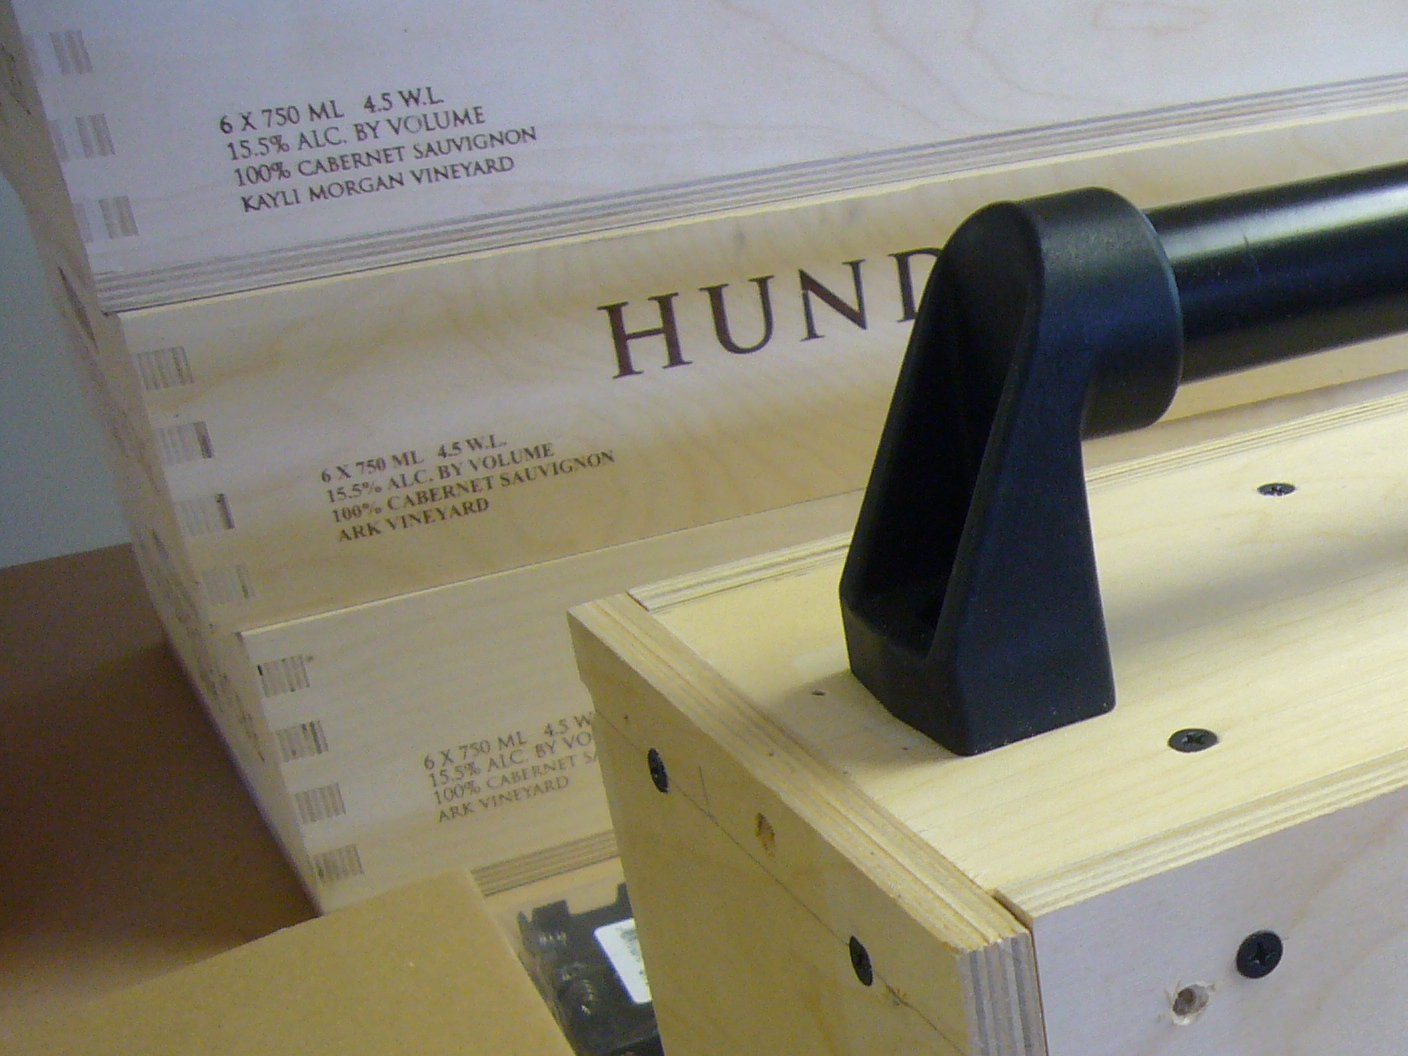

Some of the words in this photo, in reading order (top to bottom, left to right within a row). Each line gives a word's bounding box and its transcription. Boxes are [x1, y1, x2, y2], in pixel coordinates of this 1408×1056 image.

[219, 115, 233, 135] 6
[241, 111, 258, 132] X
[261, 105, 300, 129] 750
[309, 100, 344, 122] ML
[363, 92, 394, 115] 4.5
[227, 134, 290, 161] 15.5%
[297, 126, 348, 151] ALC.
[354, 121, 381, 143] BY
[388, 106, 486, 135] VOLUME
[234, 160, 291, 187] 100%
[297, 145, 407, 178] CABERNET
[413, 126, 537, 160] SAUVIGNON
[241, 188, 301, 213] KAYLI
[309, 171, 405, 202] MORGAN
[410, 155, 515, 185] VINEYARD
[321, 467, 332, 483] 6
[337, 464, 352, 481] X
[355, 456, 386, 475] 750
[392, 450, 425, 469] ML
[437, 441, 463, 459] 4.5
[326, 480, 382, 504] 15.5%
[387, 470, 434, 490] ALC.
[438, 461, 464, 480] BY
[467, 442, 555, 473] VOLUME
[332, 501, 382, 523] 100%
[386, 475, 495, 511] CABERNET
[500, 450, 615, 488] SAUVIGNON
[338, 518, 382, 542] ARK
[386, 497, 490, 531] VINEYARD
[424, 753, 436, 771] 6
[457, 739, 492, 761] 750
[497, 730, 528, 751] ML
[428, 760, 482, 788] 15.5%
[535, 739, 558, 759] BY
[433, 779, 481, 806] 100%
[486, 753, 578, 790] CABERNET
[438, 801, 476, 823] ARK
[477, 774, 570, 809] VINEYARD
